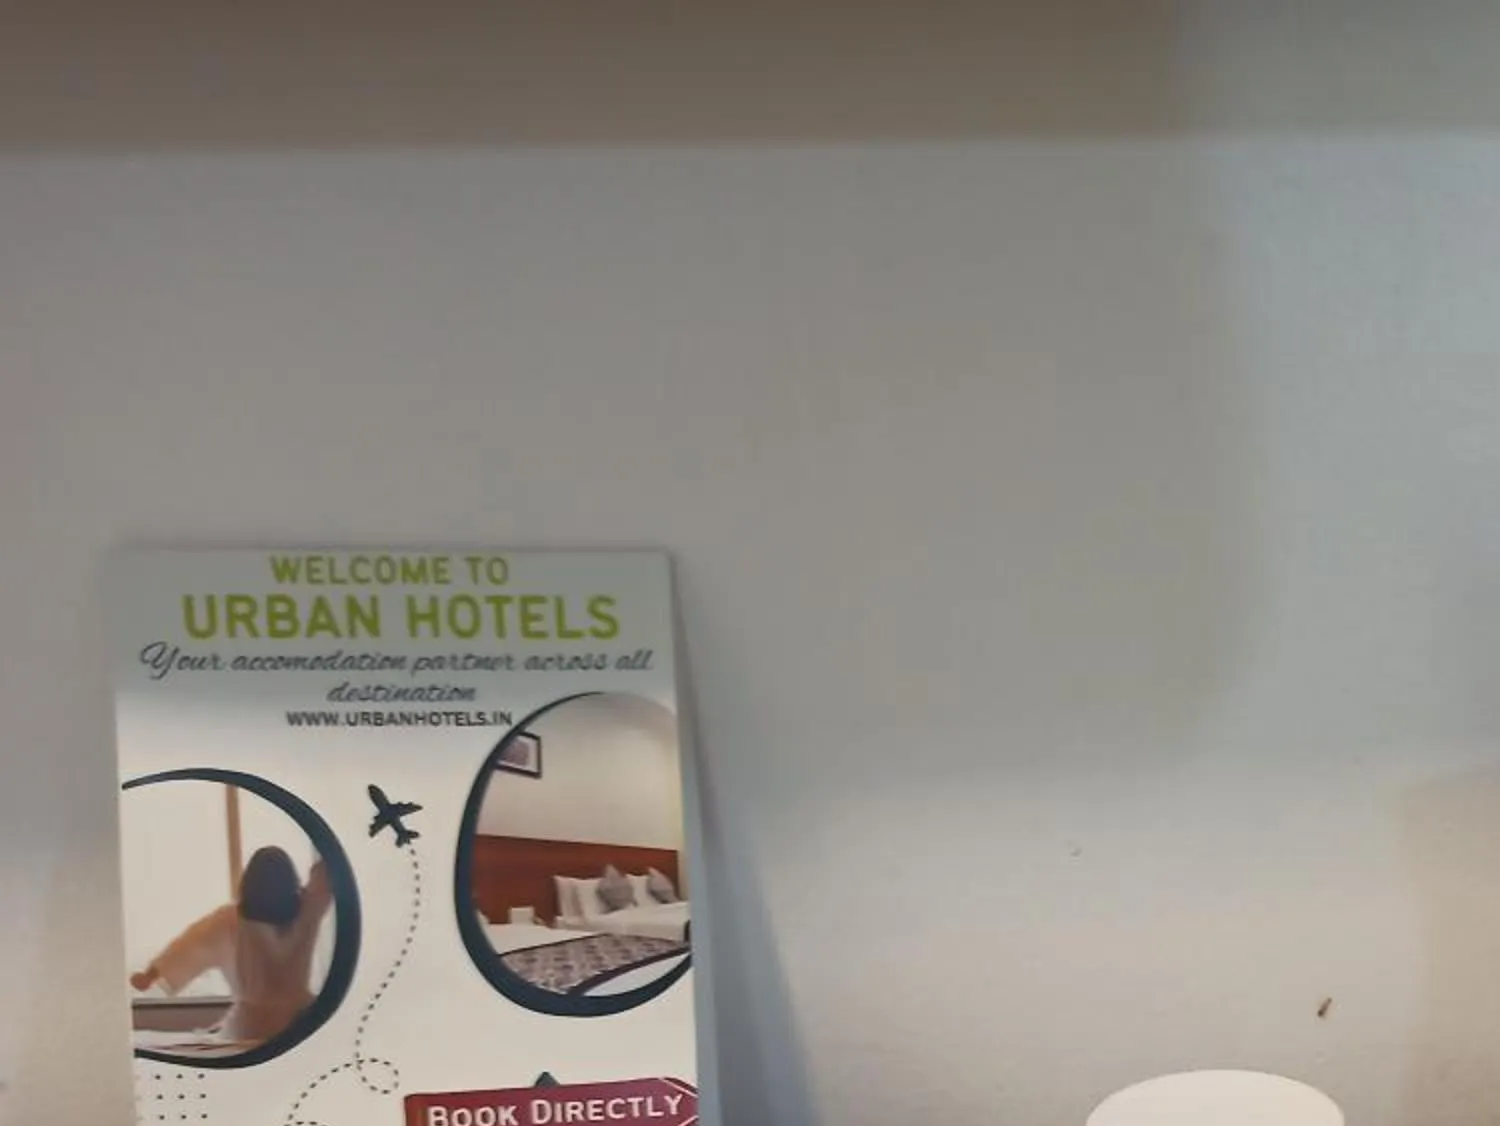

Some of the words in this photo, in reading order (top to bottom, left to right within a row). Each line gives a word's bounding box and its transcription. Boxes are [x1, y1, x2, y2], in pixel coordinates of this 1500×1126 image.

[270, 555, 451, 585] WELCOME
[464, 556, 510, 585] TO
[183, 593, 381, 640] URBAN
[406, 594, 621, 640] HOTELS
[140, 641, 224, 680] Your
[411, 652, 516, 676] partner
[525, 652, 607, 672] across
[614, 649, 655, 671] all
[326, 681, 476, 702] destination
[286, 711, 513, 727] WWW.URBANHOTELS.IN
